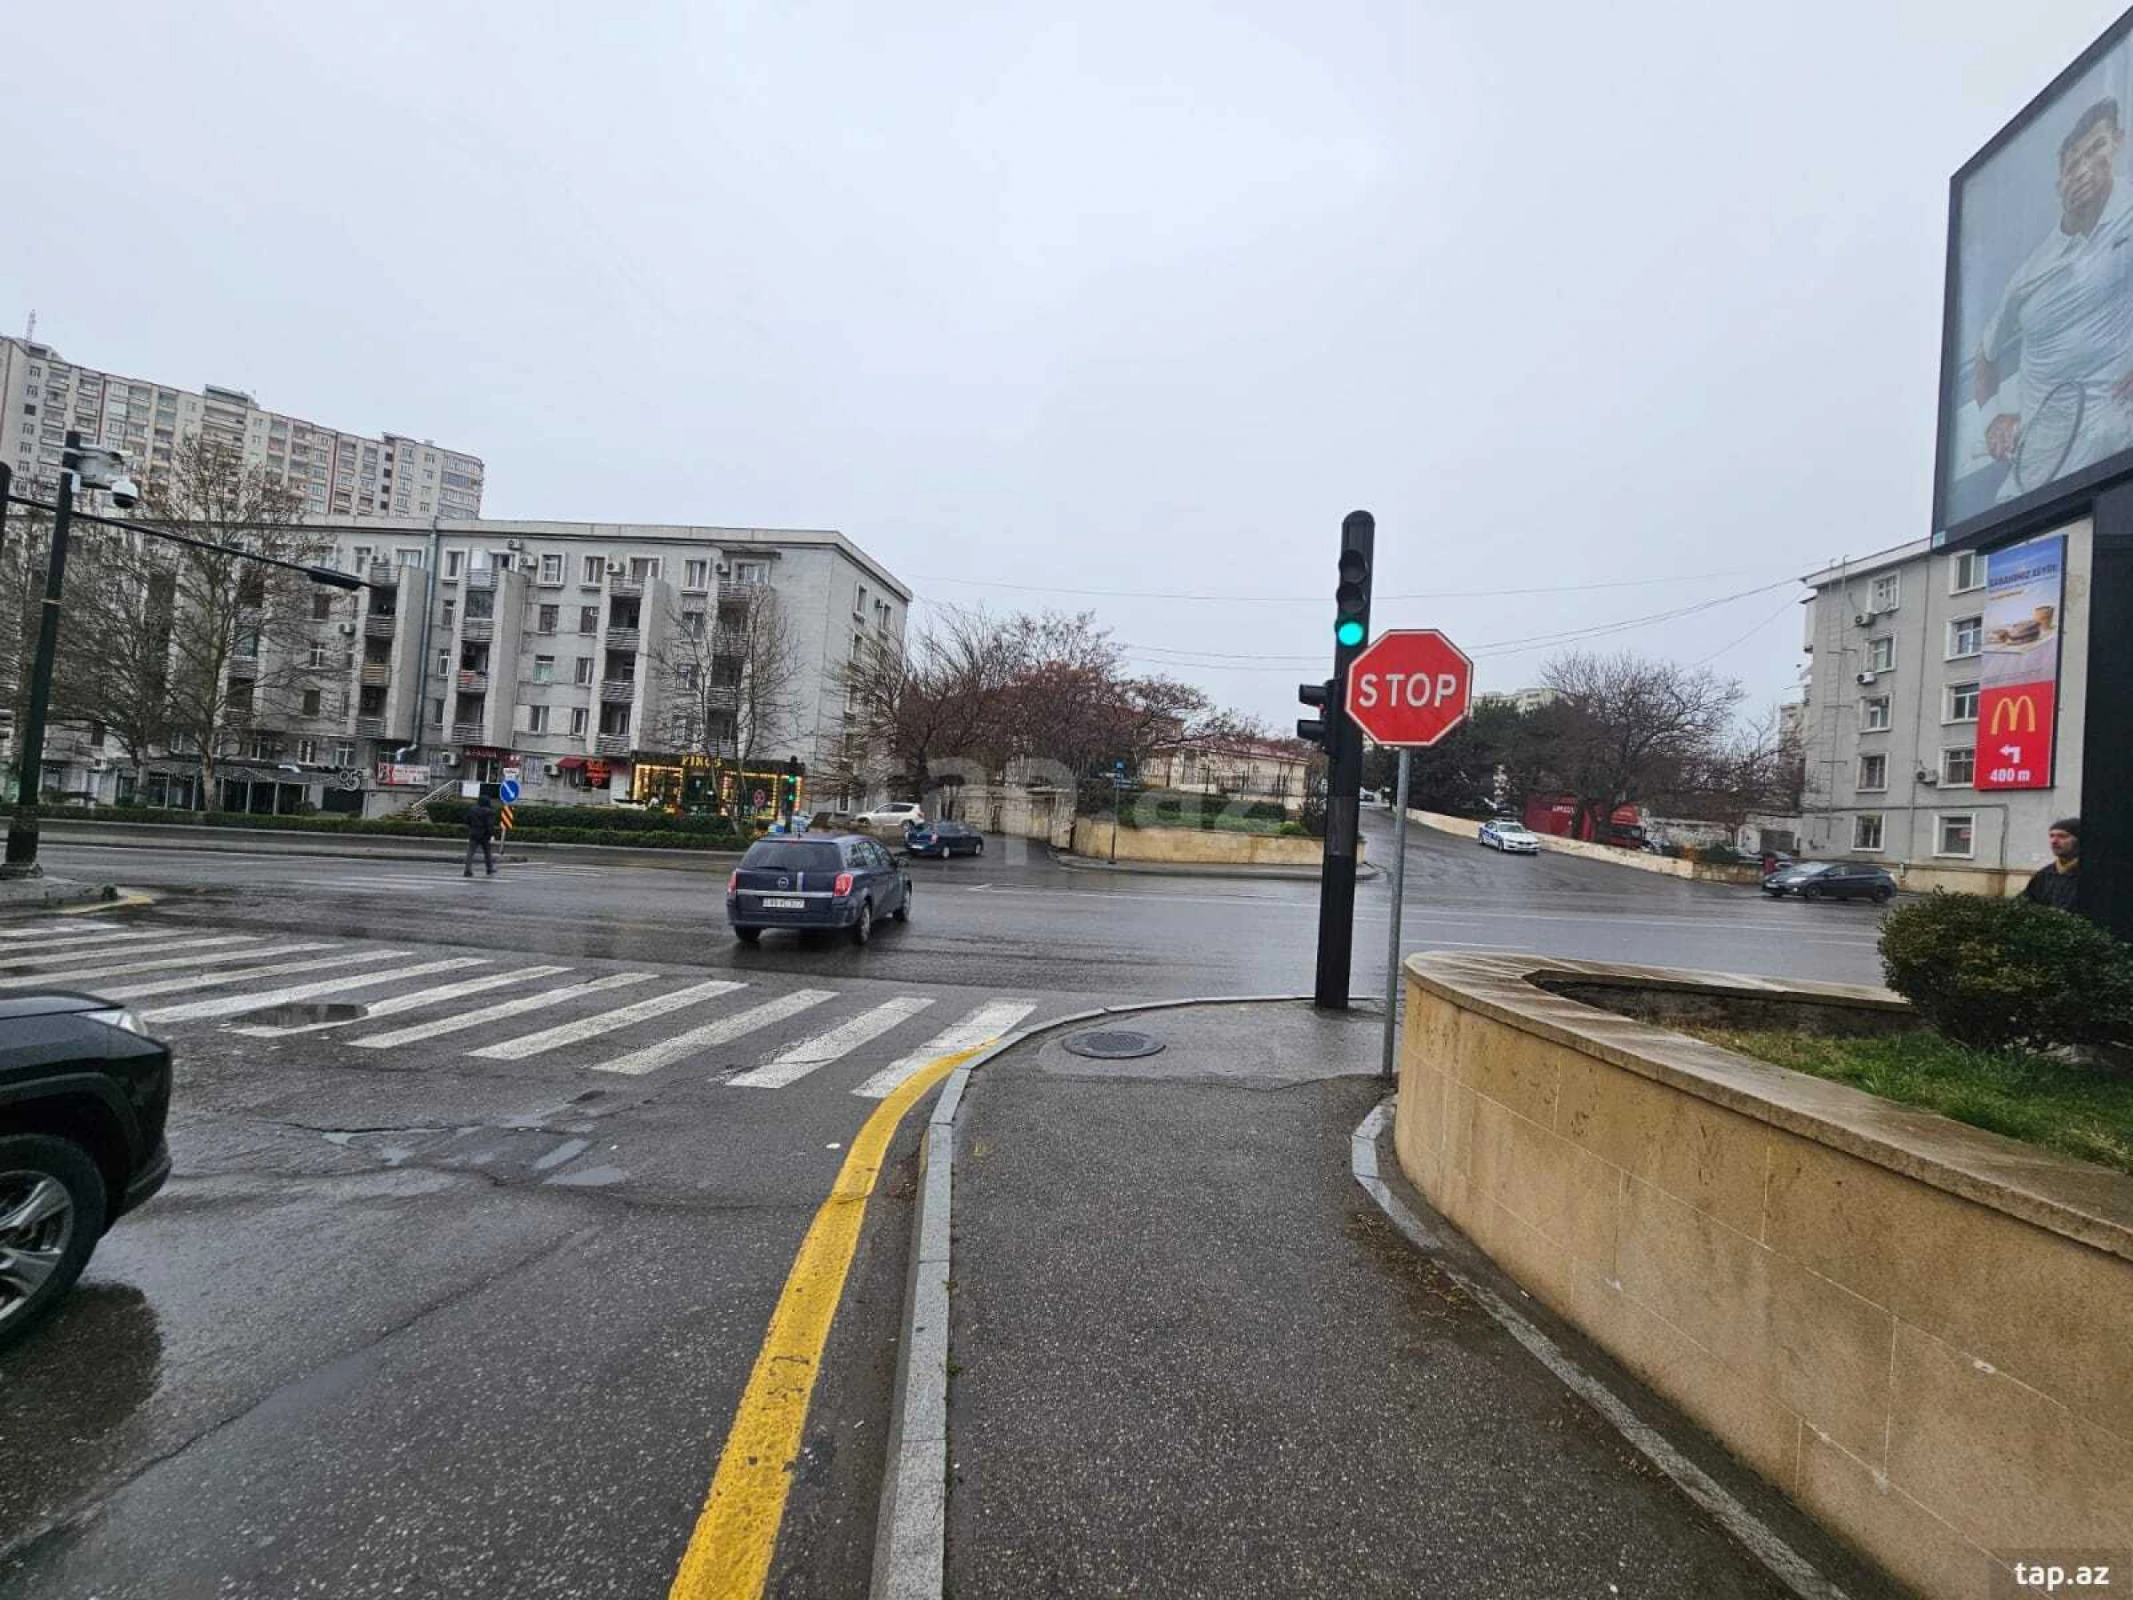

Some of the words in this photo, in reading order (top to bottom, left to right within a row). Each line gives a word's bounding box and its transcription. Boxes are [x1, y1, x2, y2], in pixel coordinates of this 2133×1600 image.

[1358, 672, 1457, 707] STOP
[1989, 767, 2015, 783] 400
[2017, 769, 2031, 782] m
